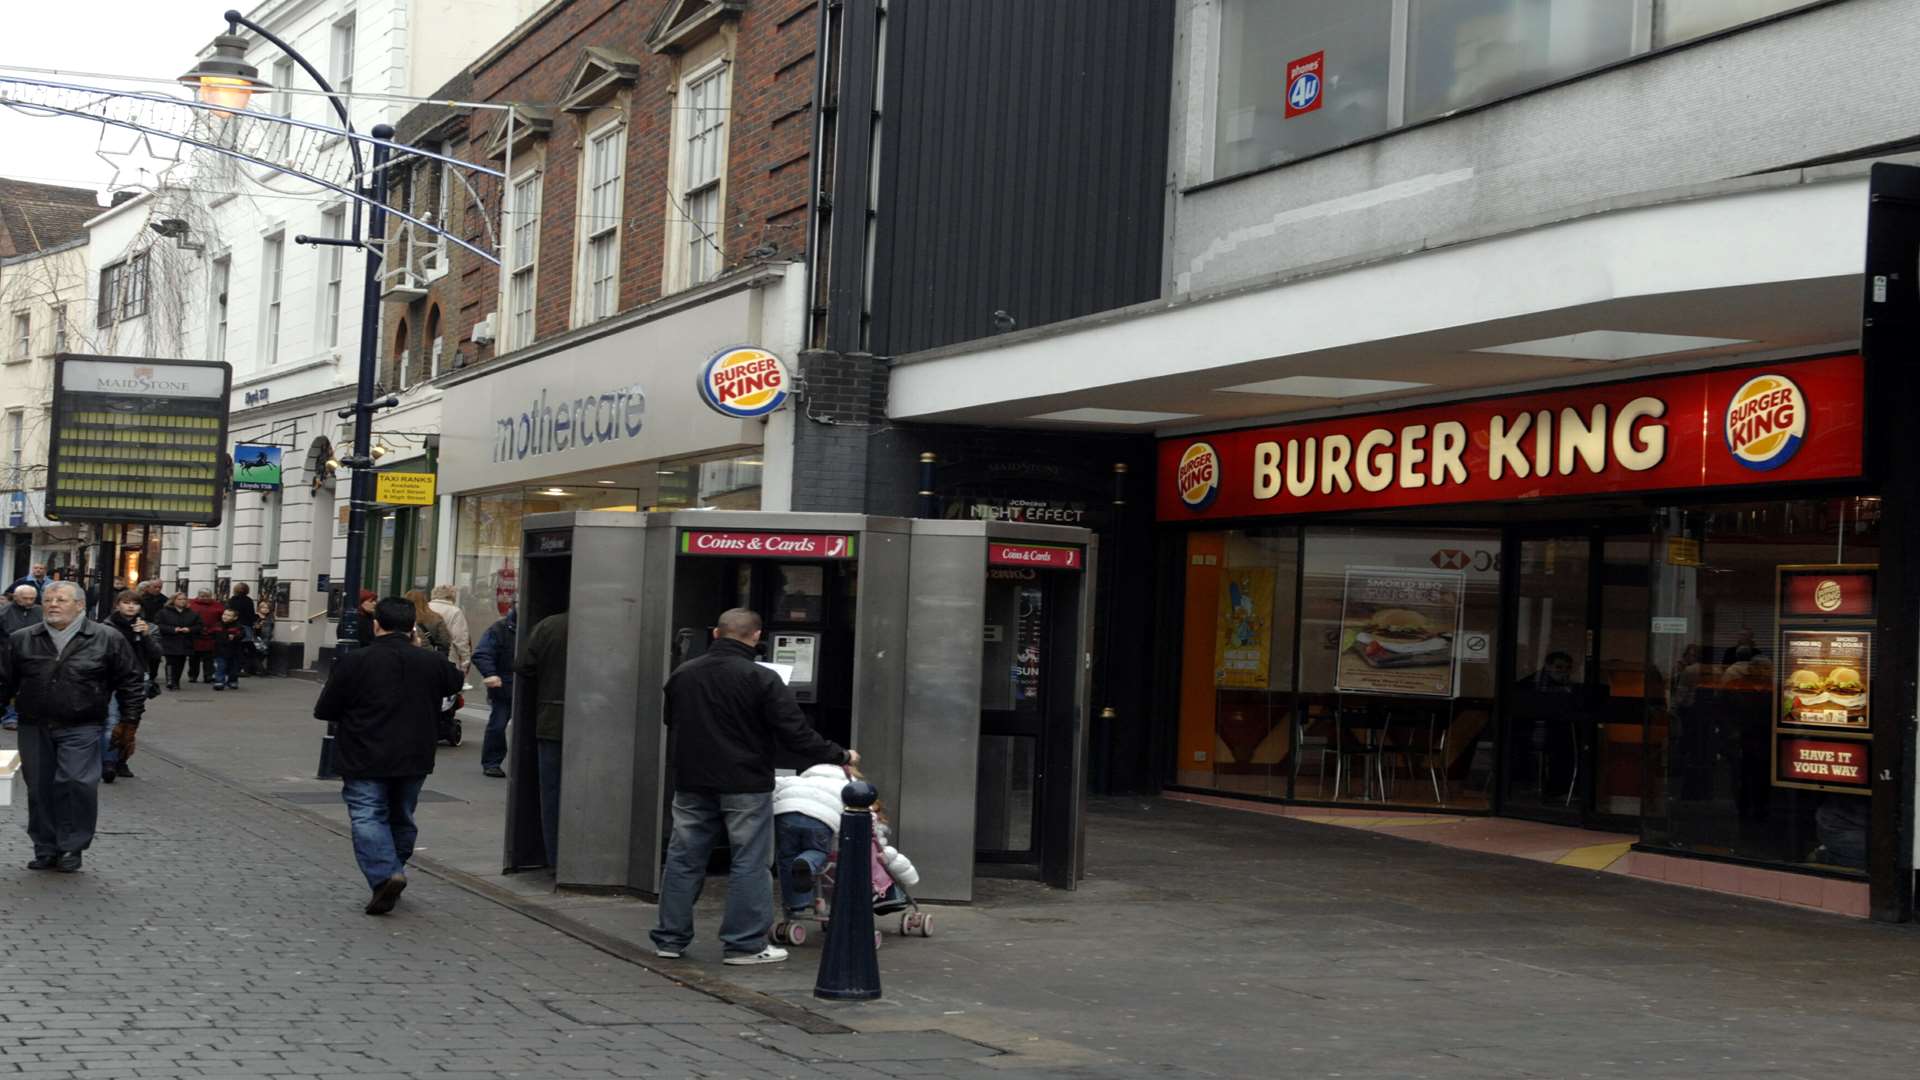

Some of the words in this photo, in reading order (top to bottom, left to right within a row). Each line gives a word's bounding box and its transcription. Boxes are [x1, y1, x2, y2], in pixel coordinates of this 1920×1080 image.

[1291, 61, 1319, 79] phones
[714, 358, 777, 385] BURGER
[97, 377, 190, 392] MAIDSTONE
[718, 370, 781, 403] KING
[1729, 387, 1793, 428] BURGER
[493, 387, 646, 463] mothercare
[1732, 404, 1794, 452] KING
[1252, 420, 1468, 500] BURGER
[1489, 396, 1666, 481] KING
[1180, 452, 1212, 480] BURGER
[379, 474, 398, 482] TAXI
[400, 475, 433, 484] RANKS
[1180, 464, 1213, 496] KING
[970, 504, 1022, 520] NIGHT
[1025, 507, 1085, 523] EFFECT
[697, 534, 745, 550] Coins
[746, 537, 762, 551] &
[765, 536, 816, 552] Cards
[1002, 548, 1023, 560] Coins
[1030, 549, 1052, 562] Cards
[1799, 749, 1835, 762] HAVE
[1837, 752, 1853, 763] IT
[1793, 761, 1830, 774] YOUR
[1831, 764, 1859, 777] WAY
